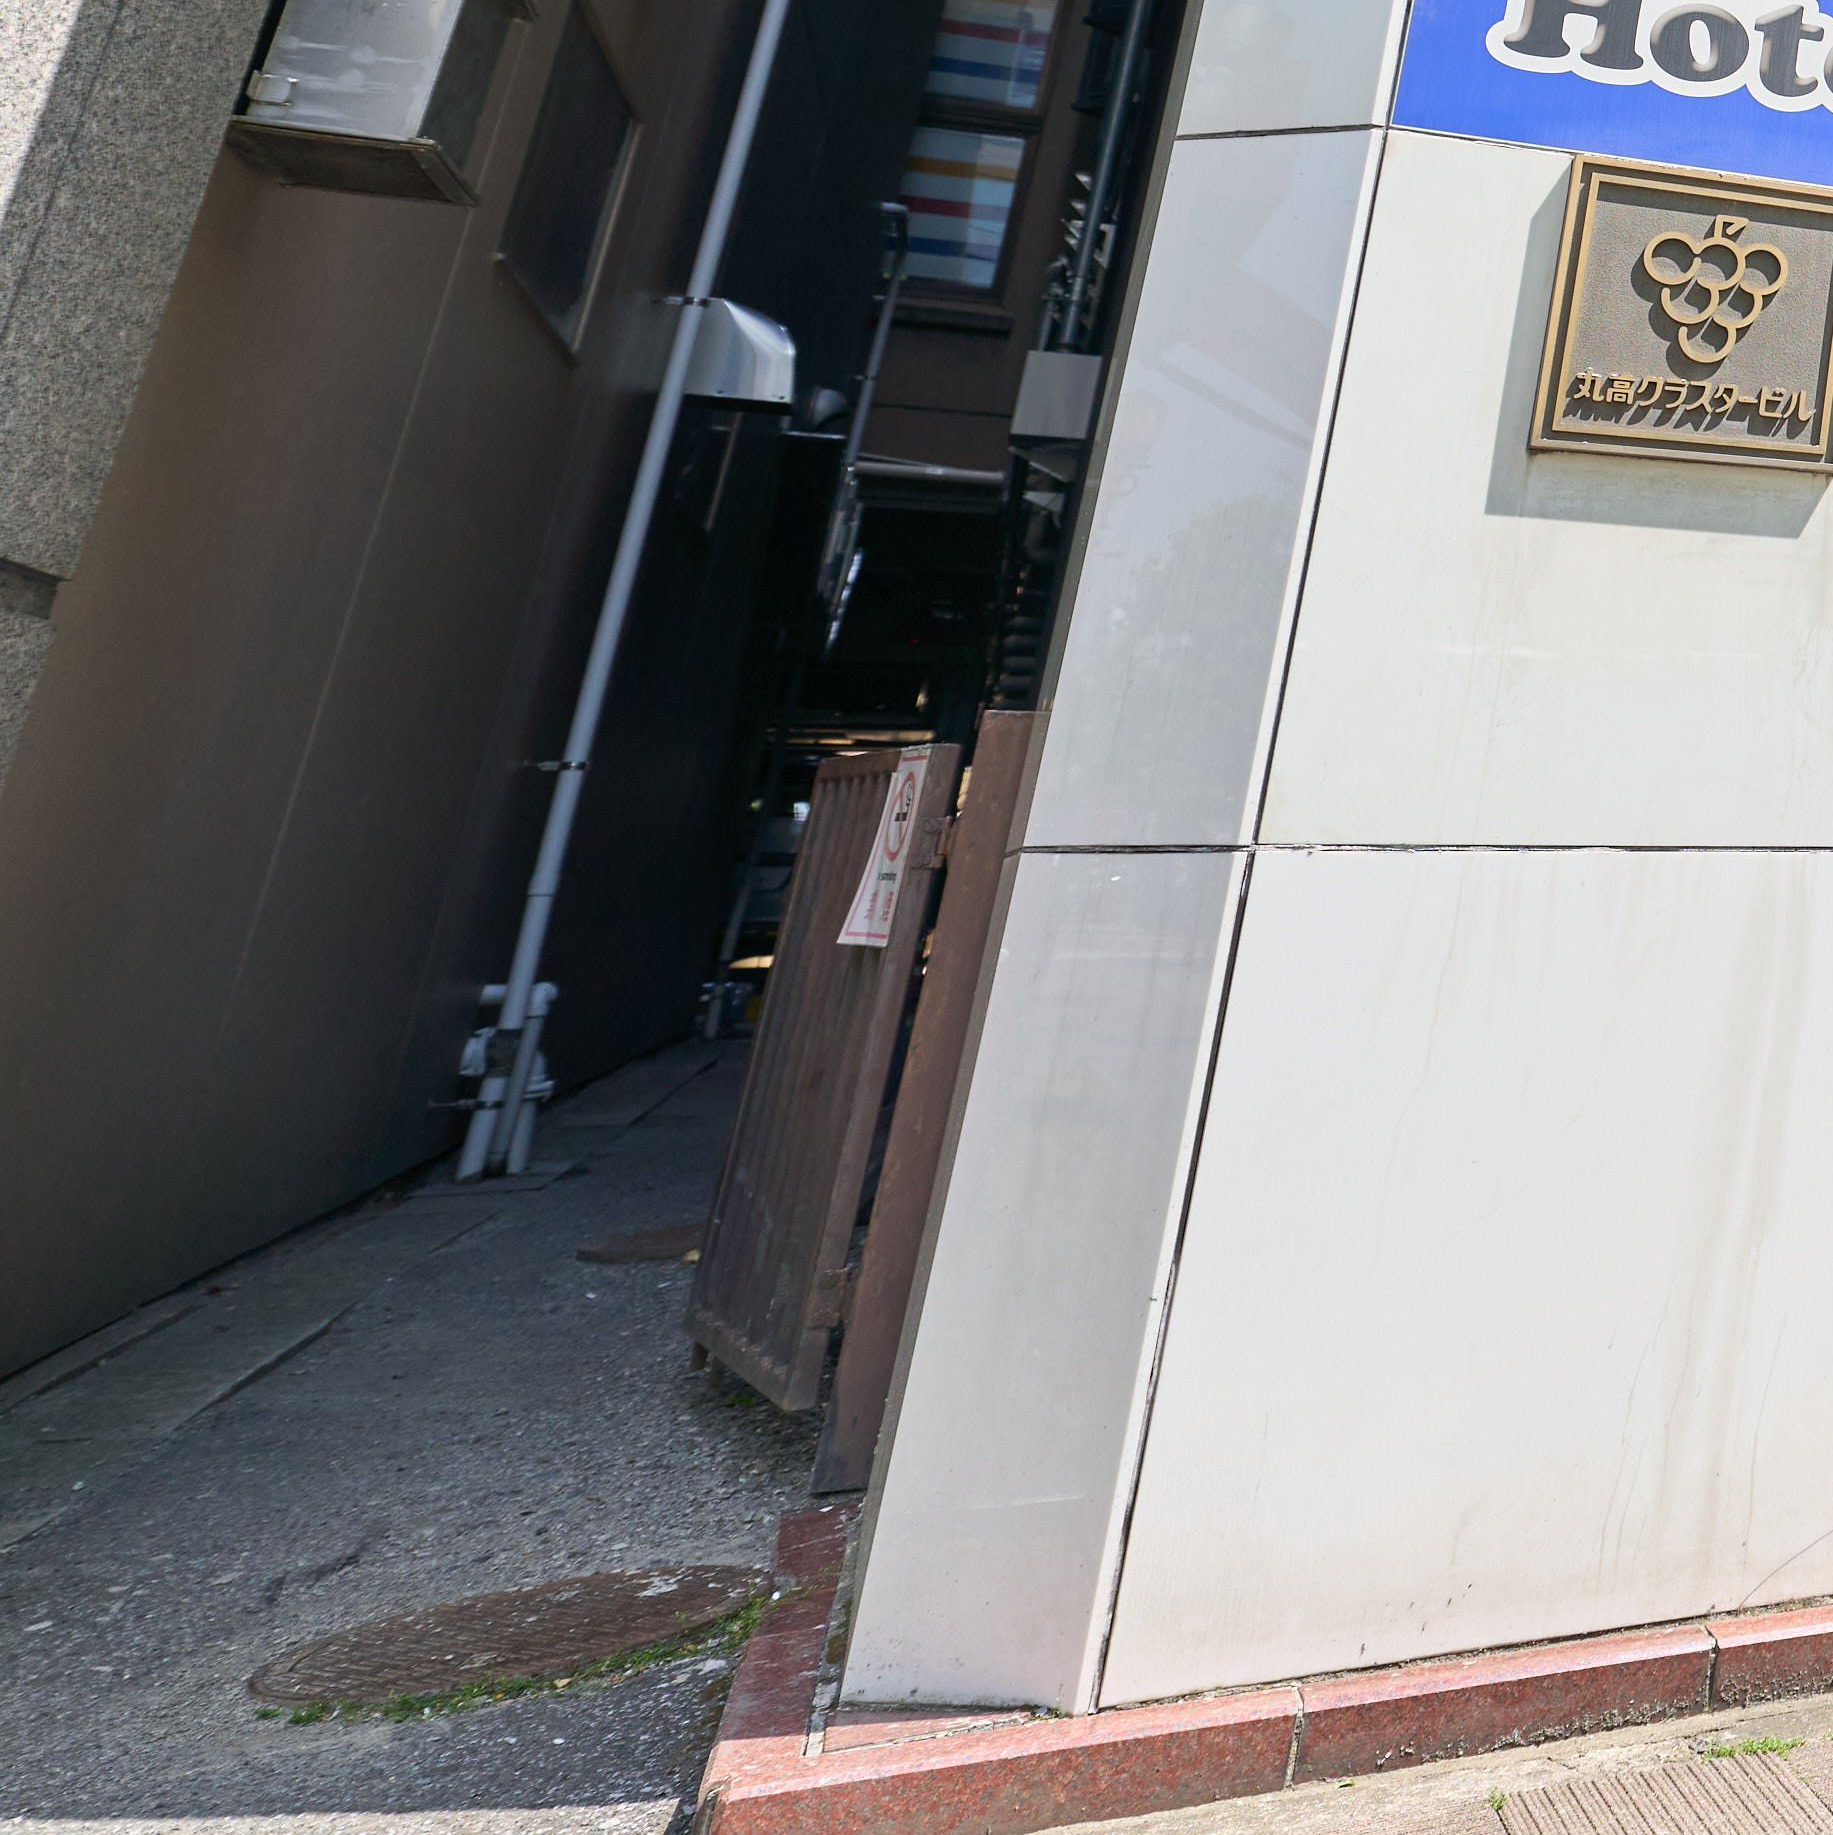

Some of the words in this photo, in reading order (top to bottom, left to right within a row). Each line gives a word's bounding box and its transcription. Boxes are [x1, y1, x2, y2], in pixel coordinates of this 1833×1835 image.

[1573, 367, 1817, 422] 丸高クラスタービル
